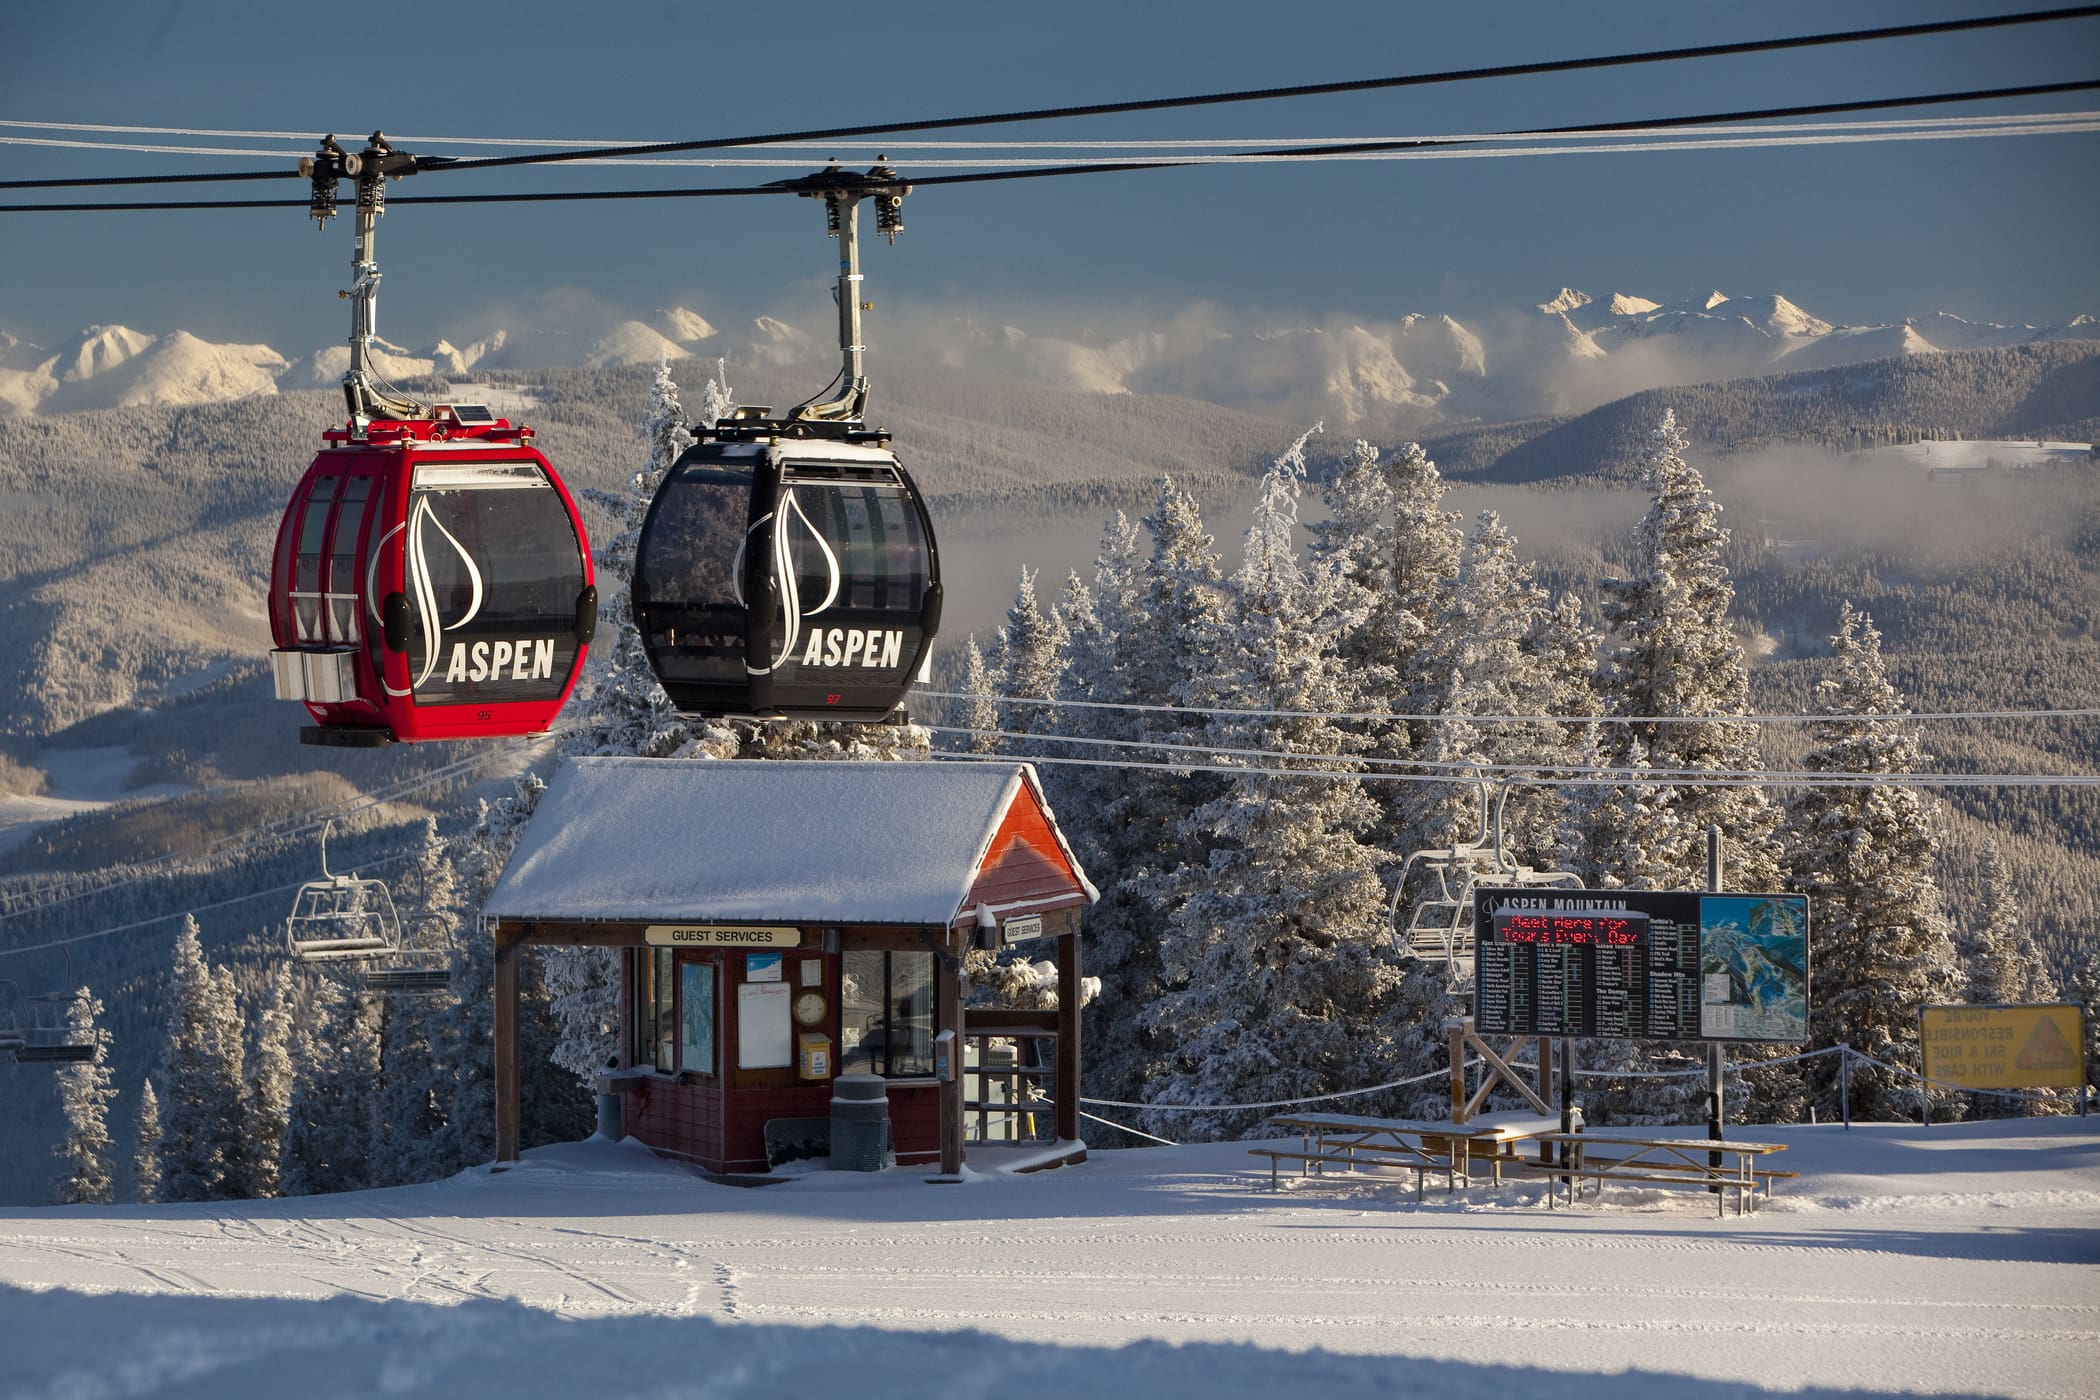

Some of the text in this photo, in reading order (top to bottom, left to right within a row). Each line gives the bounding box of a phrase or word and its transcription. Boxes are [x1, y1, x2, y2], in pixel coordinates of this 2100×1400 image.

[802, 628, 904, 668] ASPEN
[445, 639, 555, 683] ASPEN
[825, 694, 843, 705] 97
[477, 710, 493, 721] 95
[1503, 897, 1627, 911] ASPEN MOUNTAIN
[672, 930, 773, 943] GUEST SERVICES
[1007, 926, 1021, 937] GUEST
